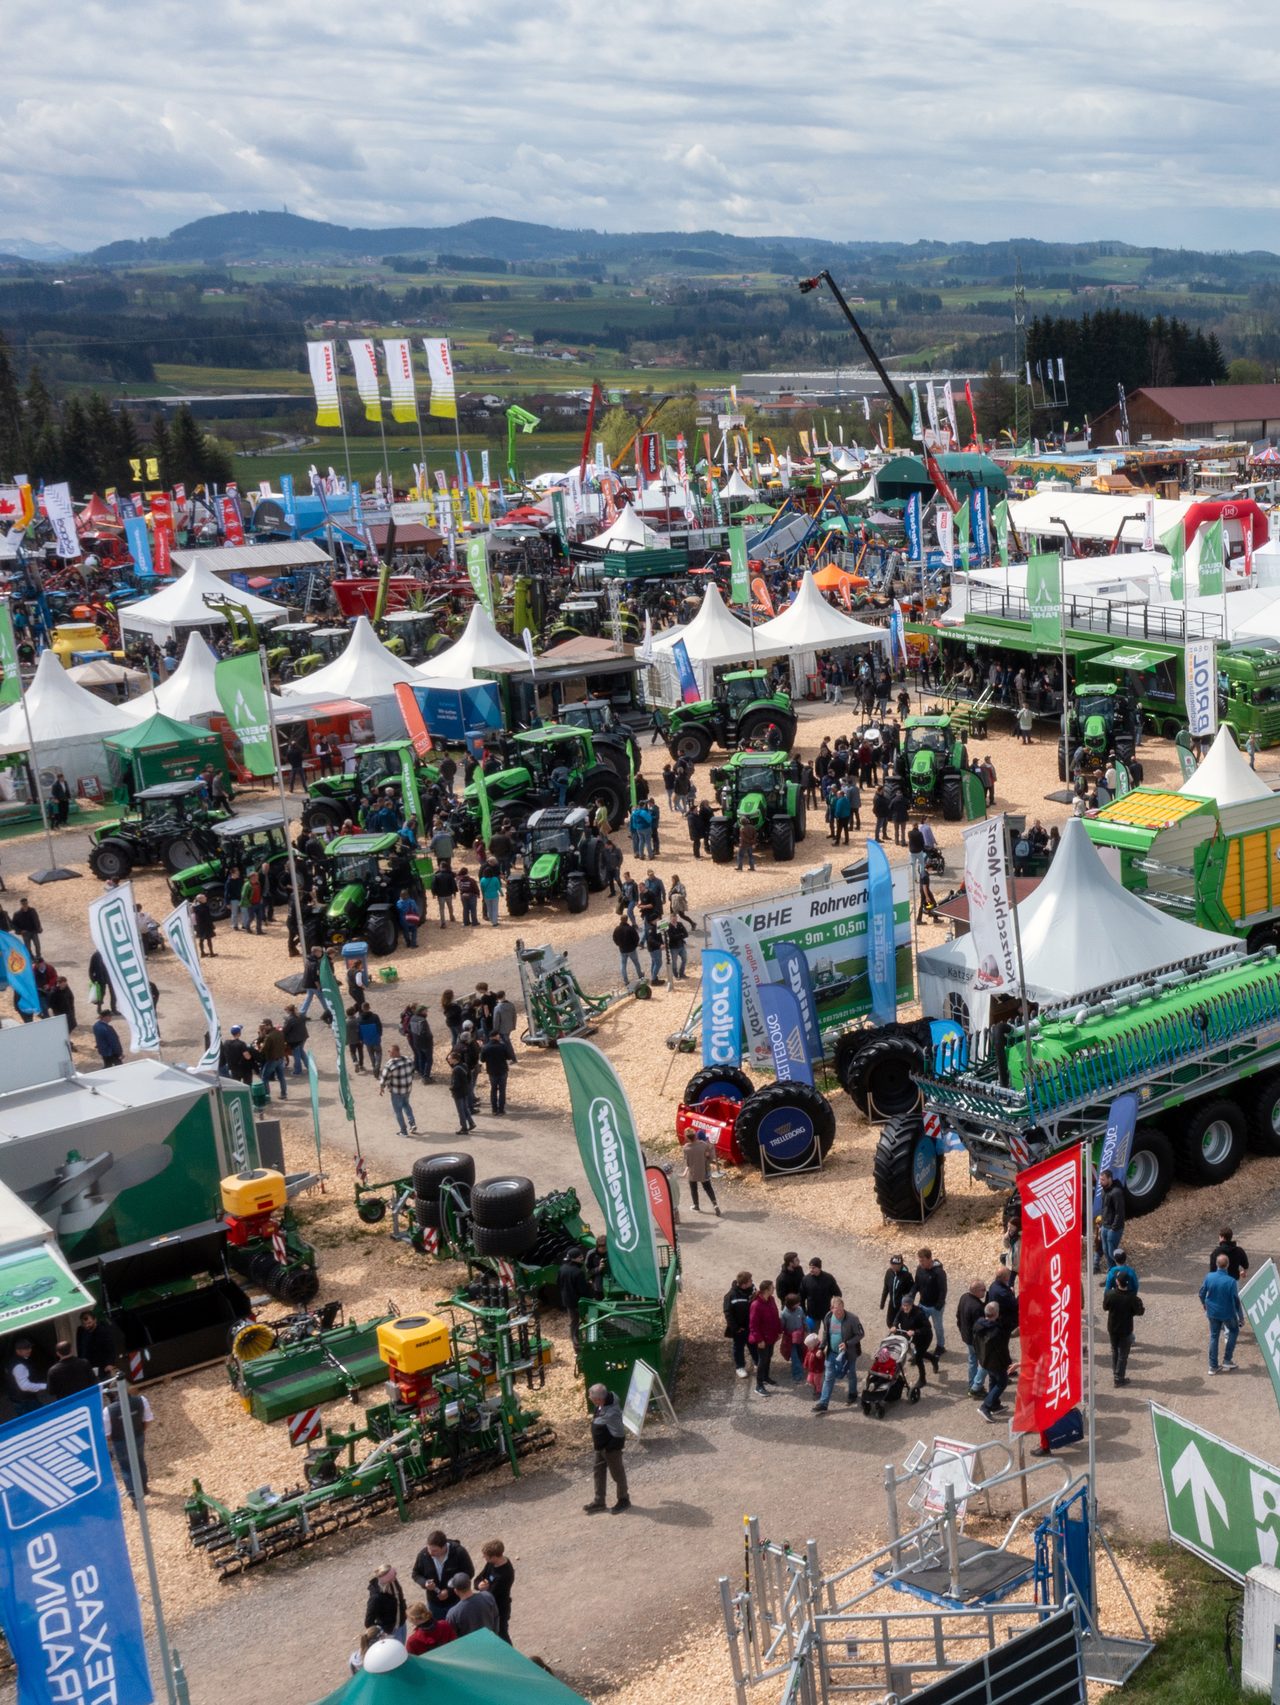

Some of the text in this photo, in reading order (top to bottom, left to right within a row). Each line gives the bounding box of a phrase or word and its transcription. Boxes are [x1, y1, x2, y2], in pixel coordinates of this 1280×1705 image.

[753, 907, 793, 932] BHE
[805, 932, 825, 945] 9m
[832, 920, 866, 938] 10,5m
[768, 1126, 807, 1148] TRELLEBORG
